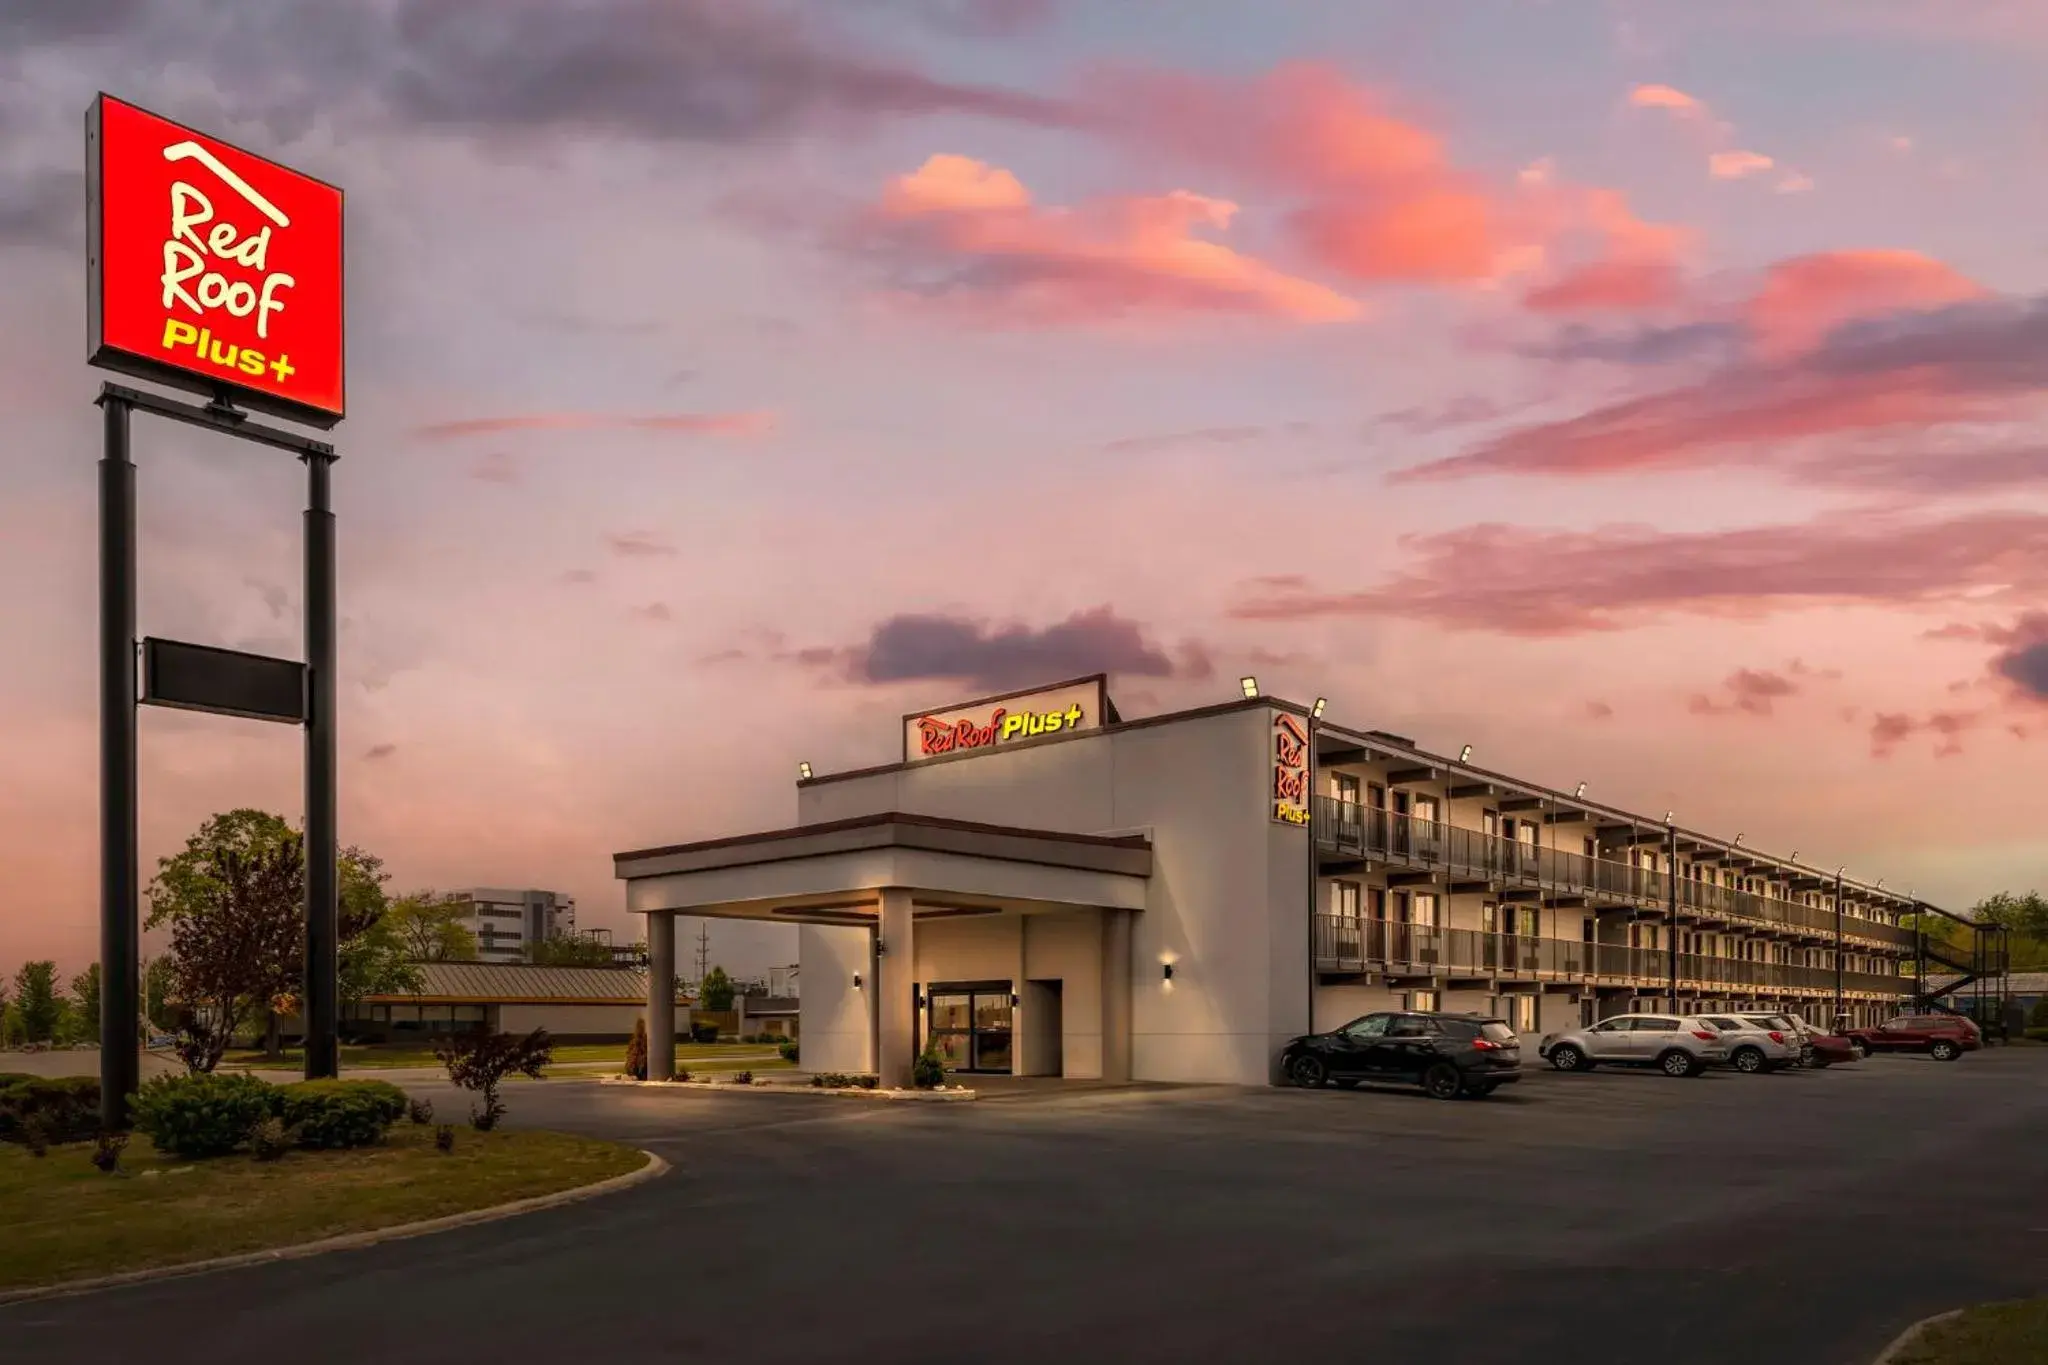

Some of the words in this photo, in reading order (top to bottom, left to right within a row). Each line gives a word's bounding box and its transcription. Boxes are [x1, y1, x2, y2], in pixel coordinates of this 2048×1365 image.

[171, 181, 271, 271] Red
[160, 239, 295, 338] Roof
[162, 318, 295, 383] Plus+
[921, 726, 957, 753] Red
[957, 707, 1006, 748] Roof
[1002, 703, 1083, 741] Plus+
[1278, 732, 1302, 767] Red
[1276, 765, 1310, 803] Roof
